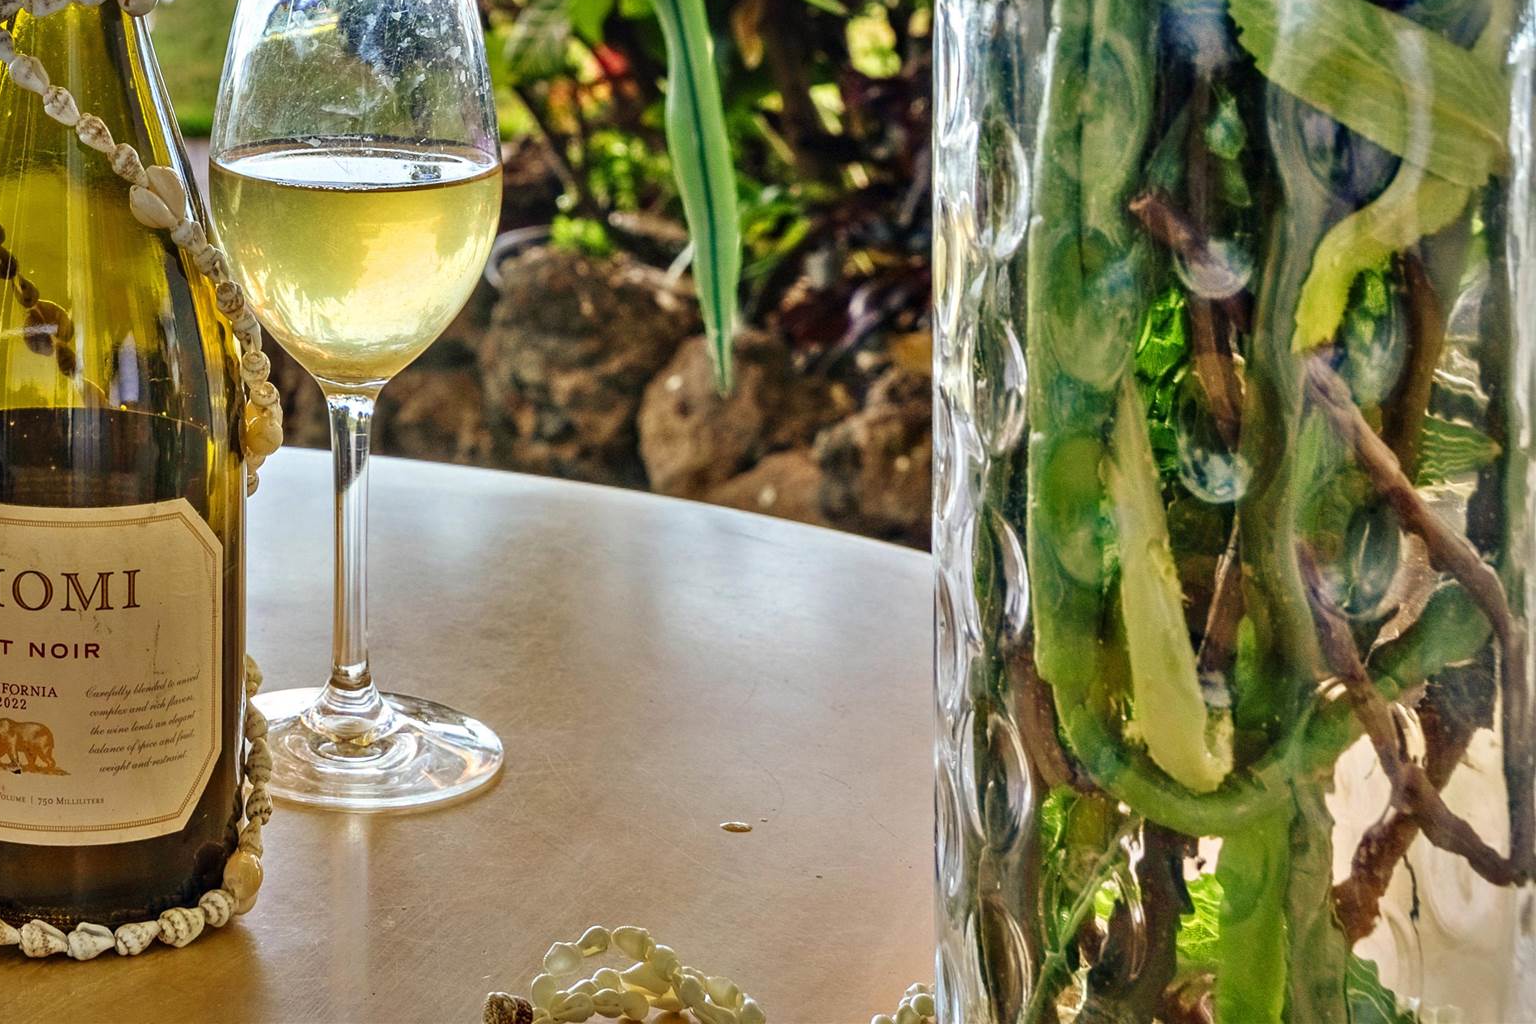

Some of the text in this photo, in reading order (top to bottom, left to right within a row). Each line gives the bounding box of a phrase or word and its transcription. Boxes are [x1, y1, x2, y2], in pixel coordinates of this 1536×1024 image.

[29, 642, 101, 659] NOIR
[85, 685, 132, 701] Carefully
[133, 678, 168, 694] blended
[89, 704, 126, 720] complex
[129, 701, 148, 714] and
[150, 699, 166, 711] rich
[90, 724, 105, 735] the
[107, 725, 129, 735] wine
[130, 719, 154, 733] lends
[155, 721, 166, 729] an
[88, 743, 125, 754] balance
[126, 739, 138, 755] of
[158, 730, 177, 747] and
[99, 759, 132, 776] weight
[131, 754, 152, 769] and
[37, 797, 54, 806] 750
